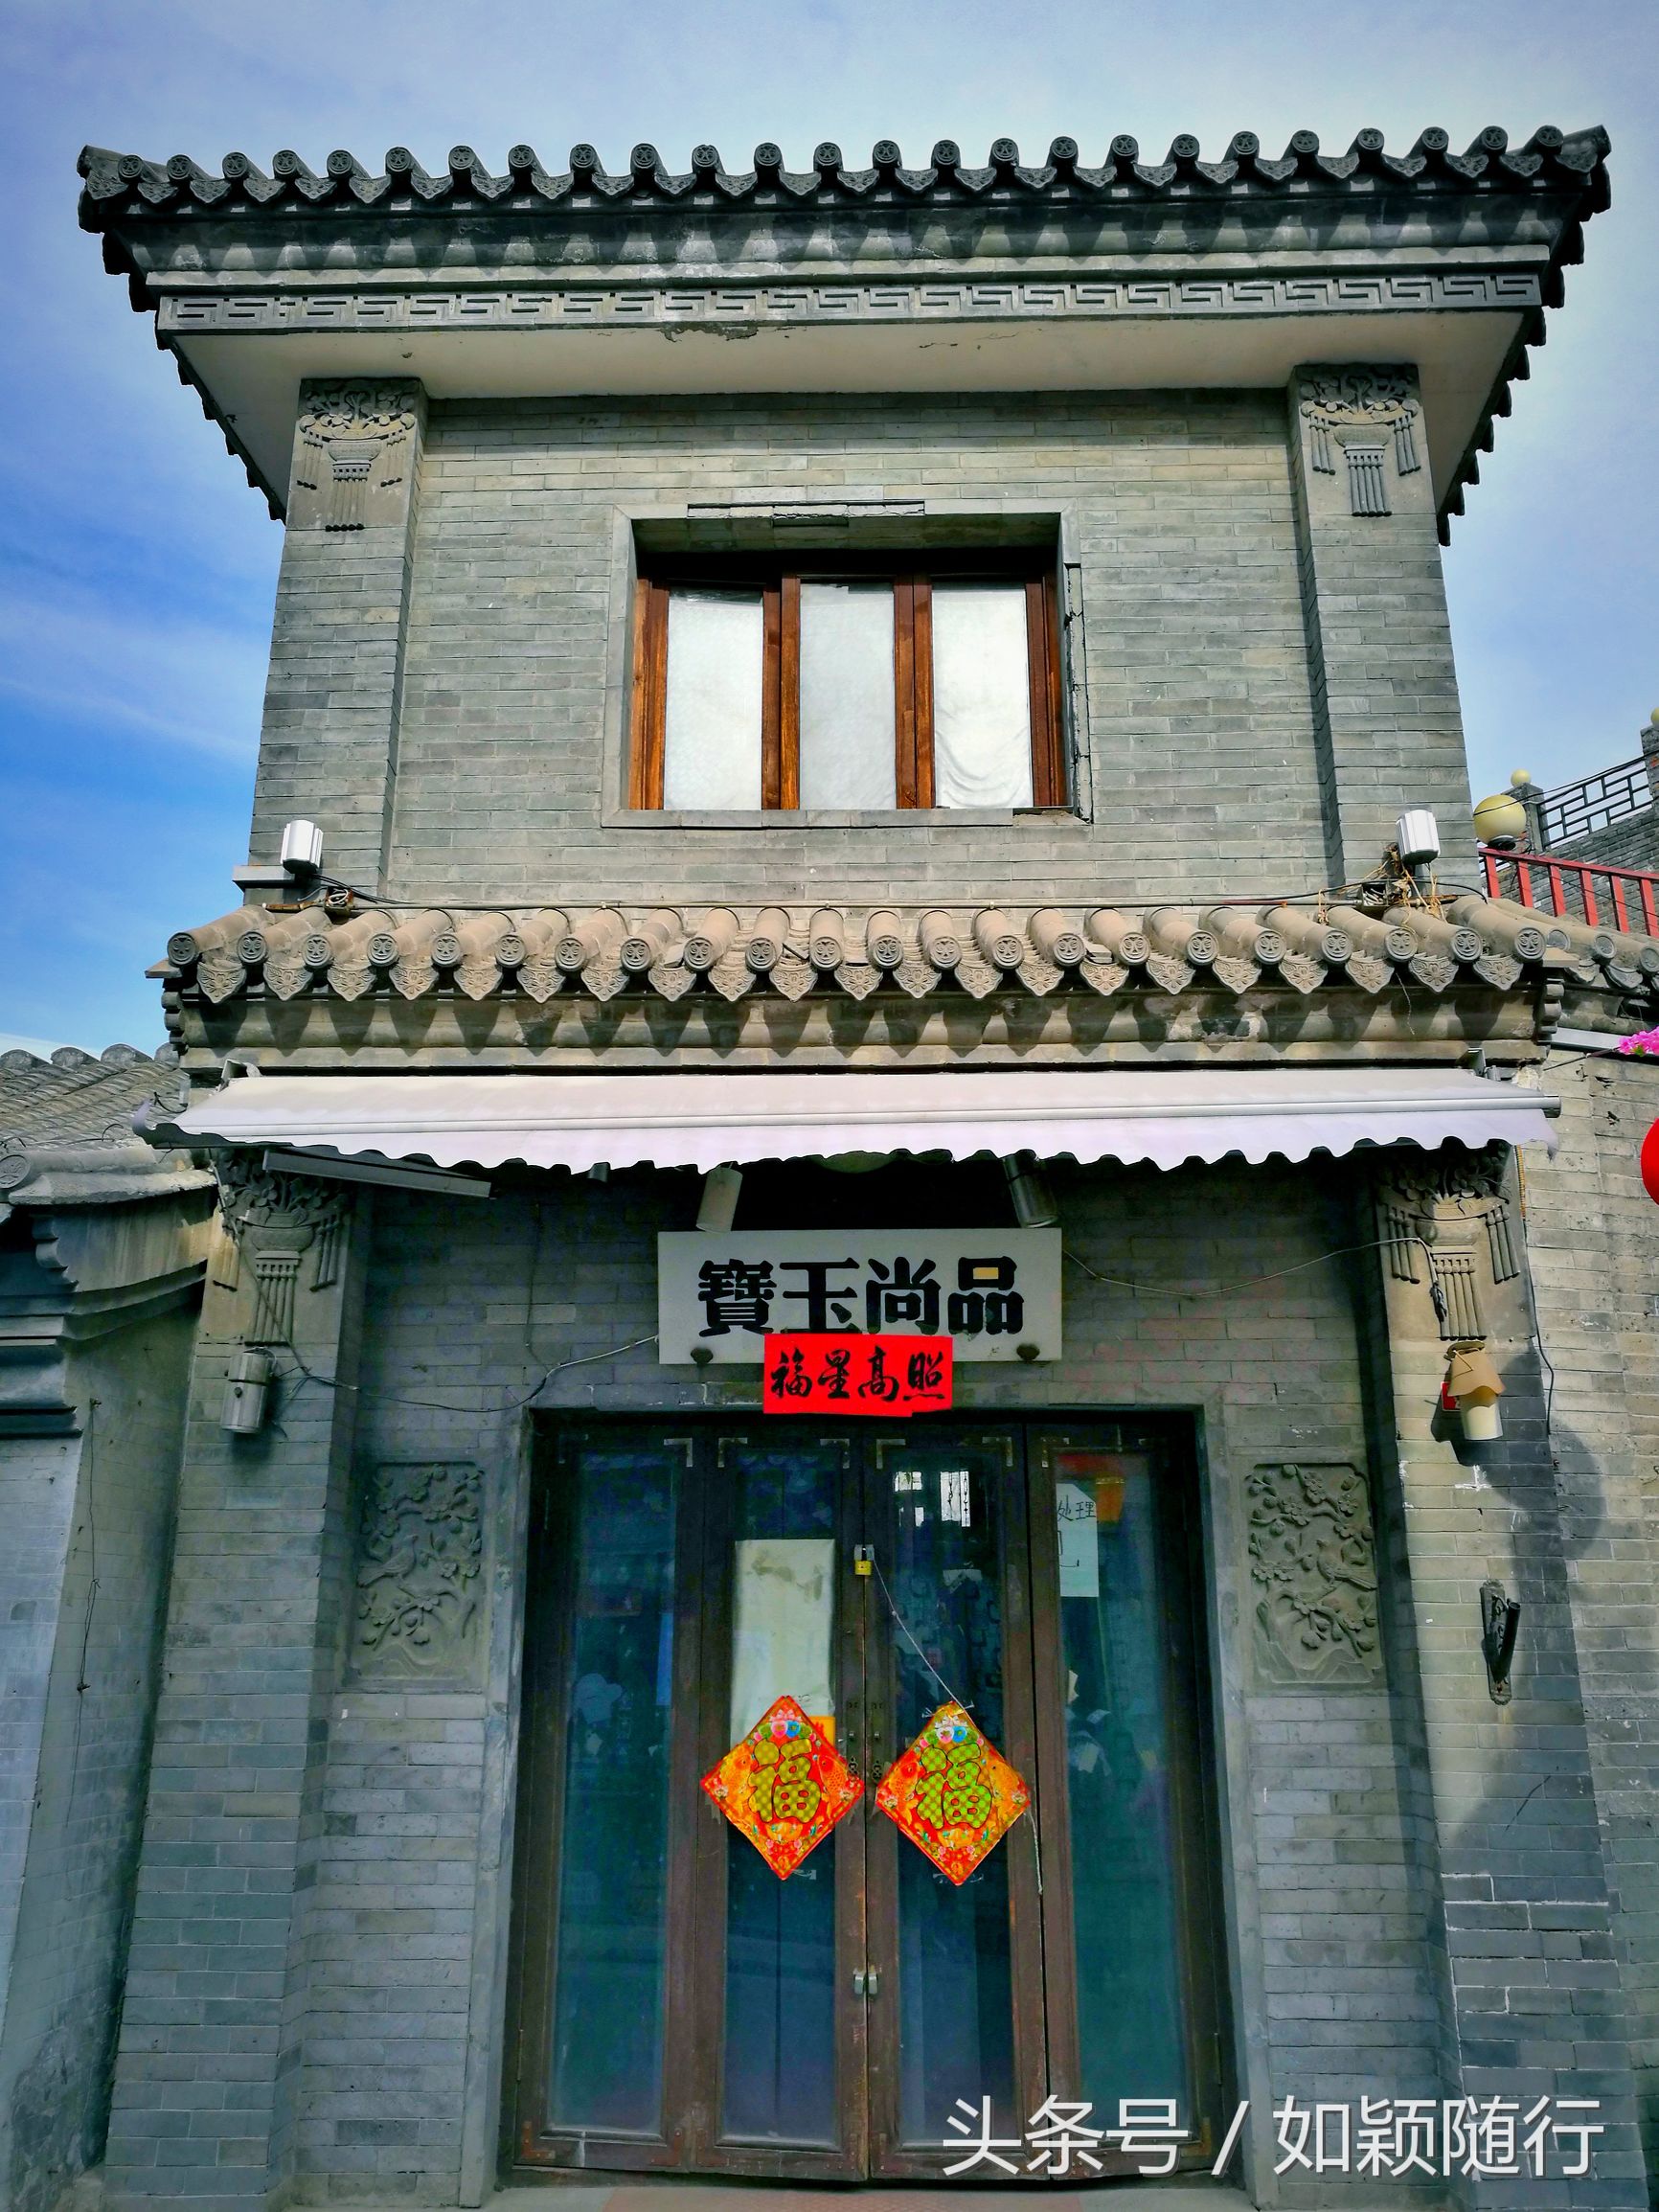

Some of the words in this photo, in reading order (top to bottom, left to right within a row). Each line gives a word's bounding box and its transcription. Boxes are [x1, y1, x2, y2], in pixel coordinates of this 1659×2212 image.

[698, 1256, 1025, 1336] 寶玉尚品
[770, 1344, 945, 1402] 福星高照
[747, 1738, 822, 1823] 福
[915, 1742, 993, 1830] 福
